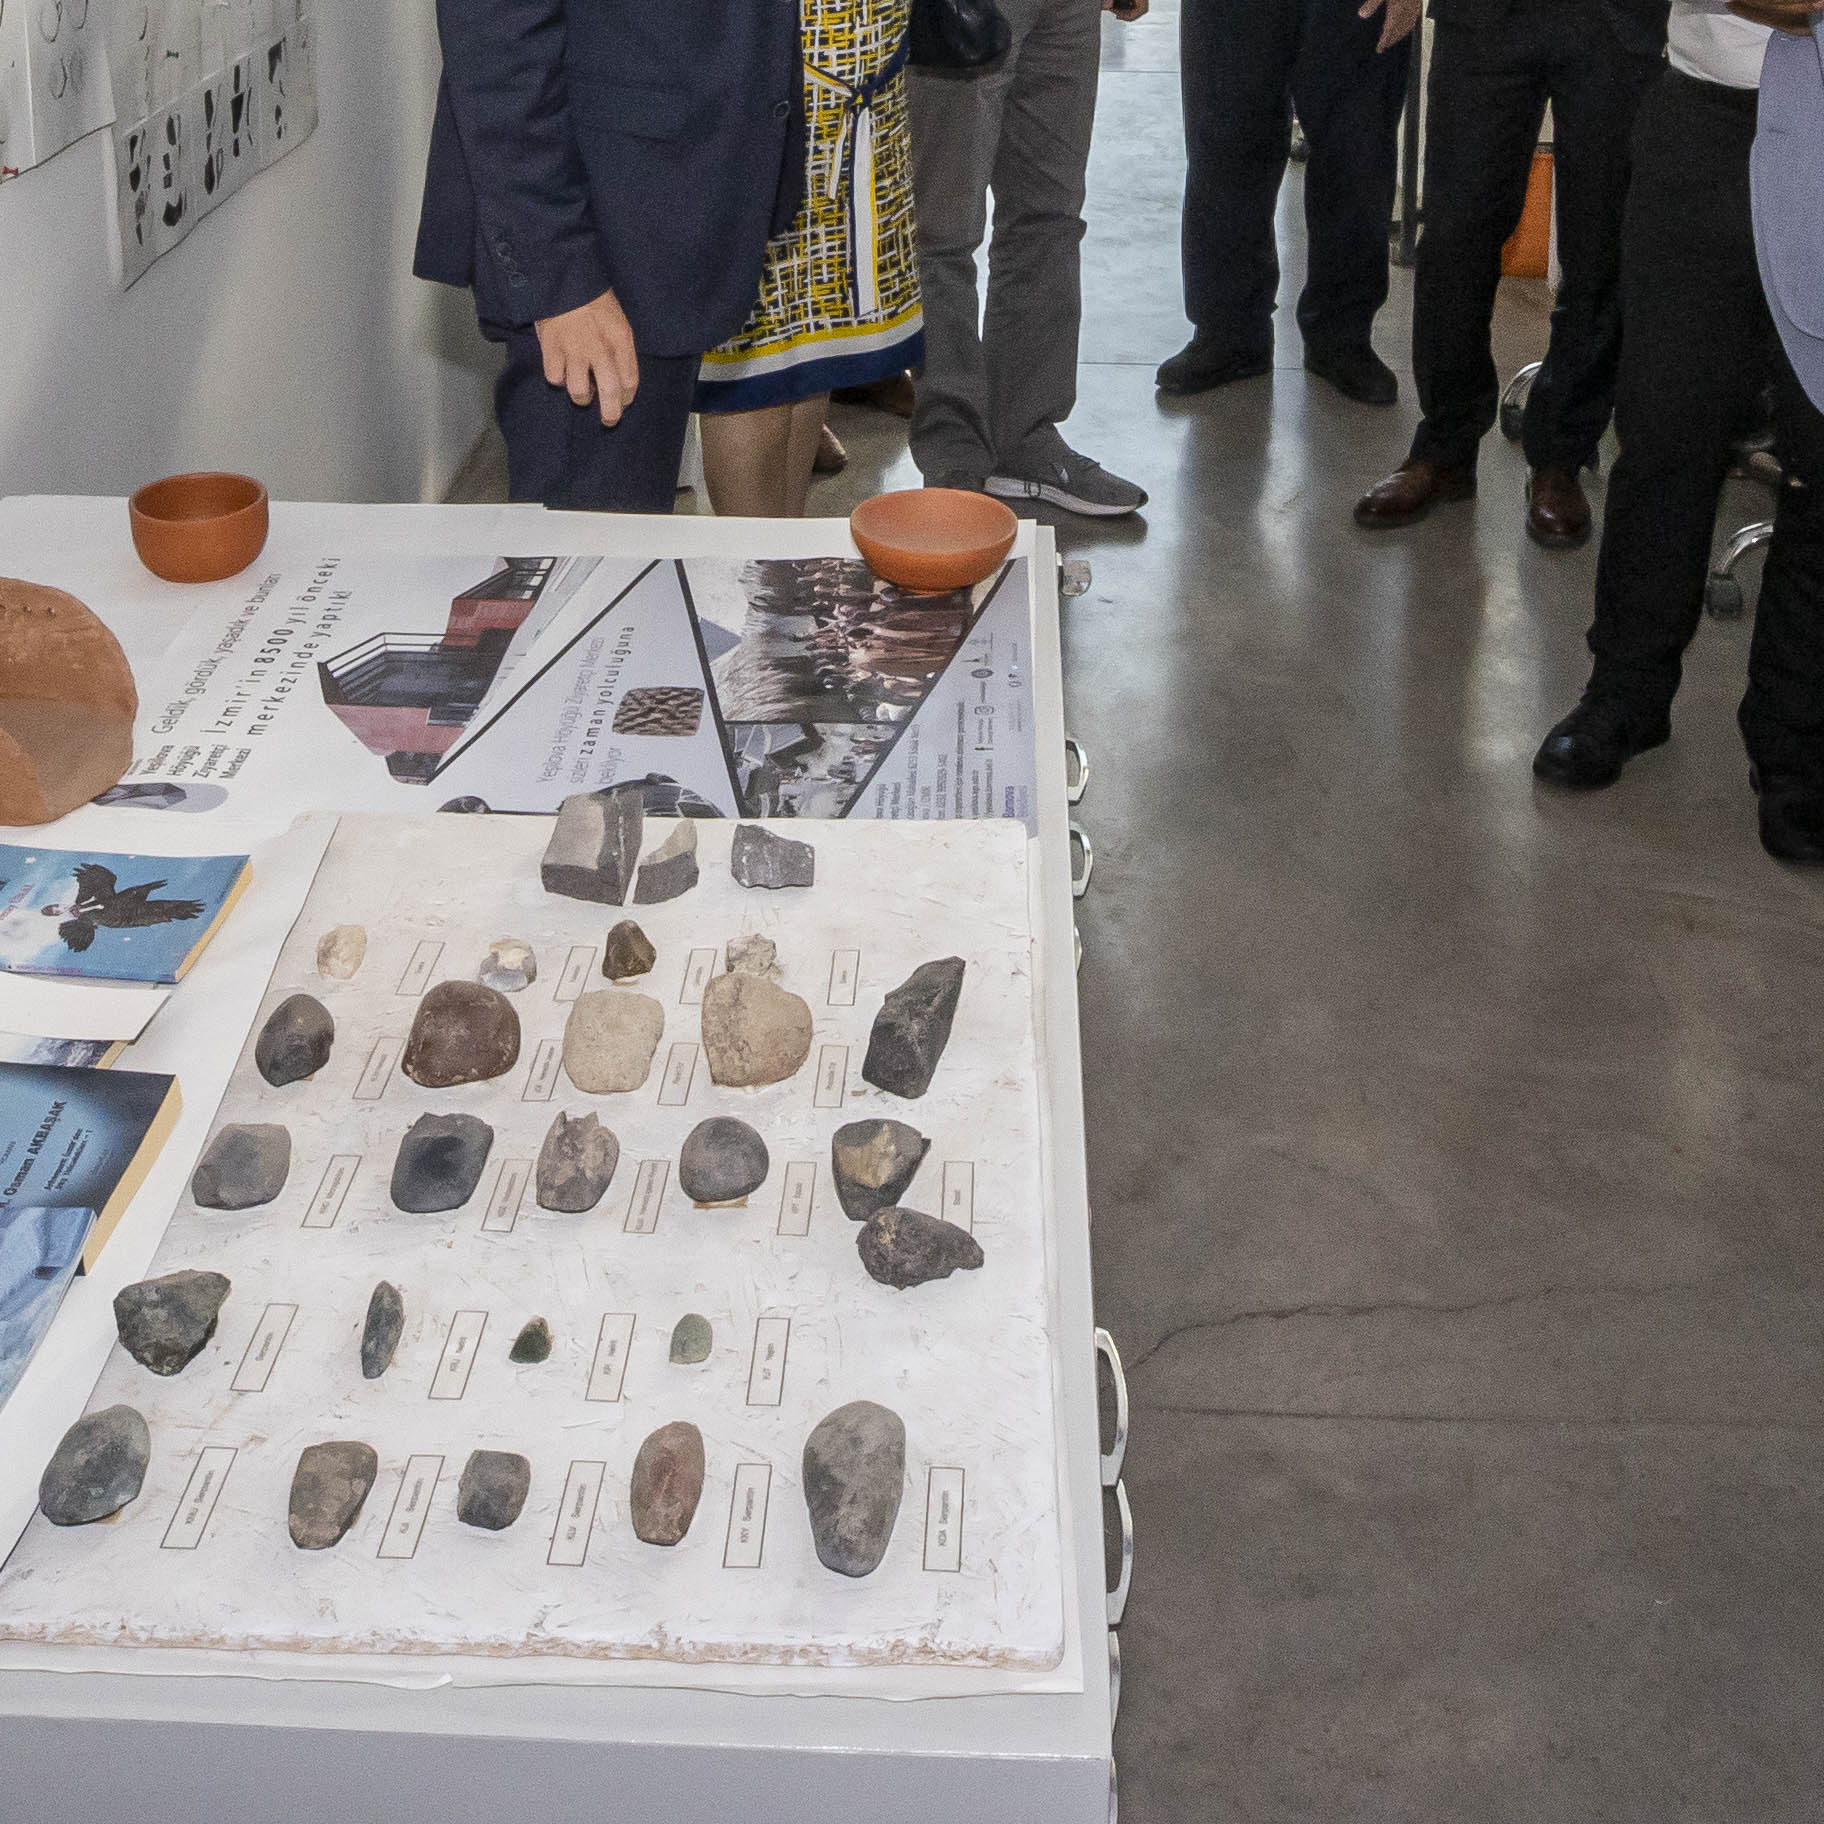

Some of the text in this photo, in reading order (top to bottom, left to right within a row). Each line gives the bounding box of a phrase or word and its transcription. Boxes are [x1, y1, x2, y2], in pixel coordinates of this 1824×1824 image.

[152, 697, 197, 734] Geldik,
[185, 656, 224, 695] gördük,
[215, 619, 251, 656] yaşadık
[243, 601, 259, 617] ve
[200, 557, 341, 733] İzmir'in 8500 yıl önceki
[246, 641, 319, 736] merkezinde
[580, 710, 606, 755] zaman
[597, 627, 635, 705] yolculuğuna
[139, 744, 175, 776] Yeşilova
[166, 745, 201, 776] Höyüğü
[192, 743, 228, 778] Ziyaretçi
[219, 747, 252, 780] Merkezi
[3, 1155, 33, 1197] Osman
[30, 1100, 68, 1156] AKBAŞAK
